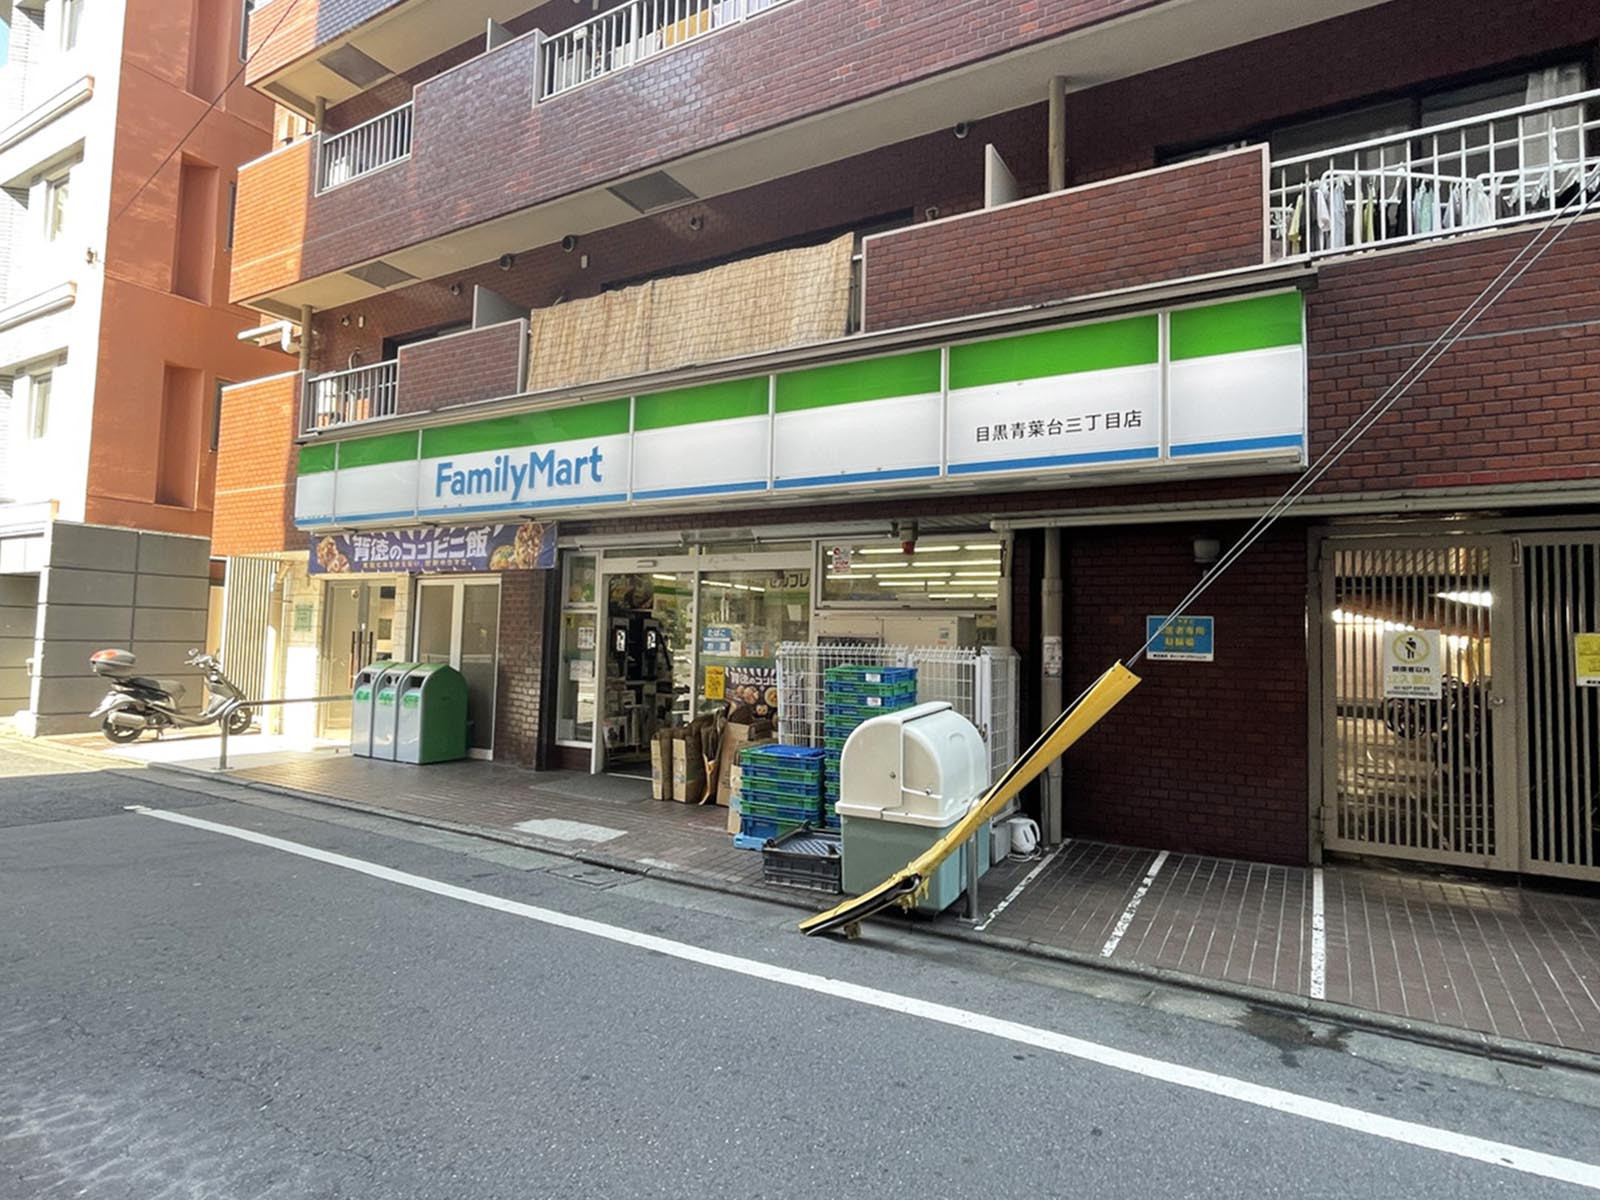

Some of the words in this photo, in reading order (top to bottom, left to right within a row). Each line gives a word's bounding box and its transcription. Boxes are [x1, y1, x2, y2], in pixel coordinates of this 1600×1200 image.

[975, 409, 1143, 443] 目黒青葉台三丁目店
[435, 446, 603, 500] FamilyMart
[353, 528, 490, 561] 背徳のコンビニ飯
